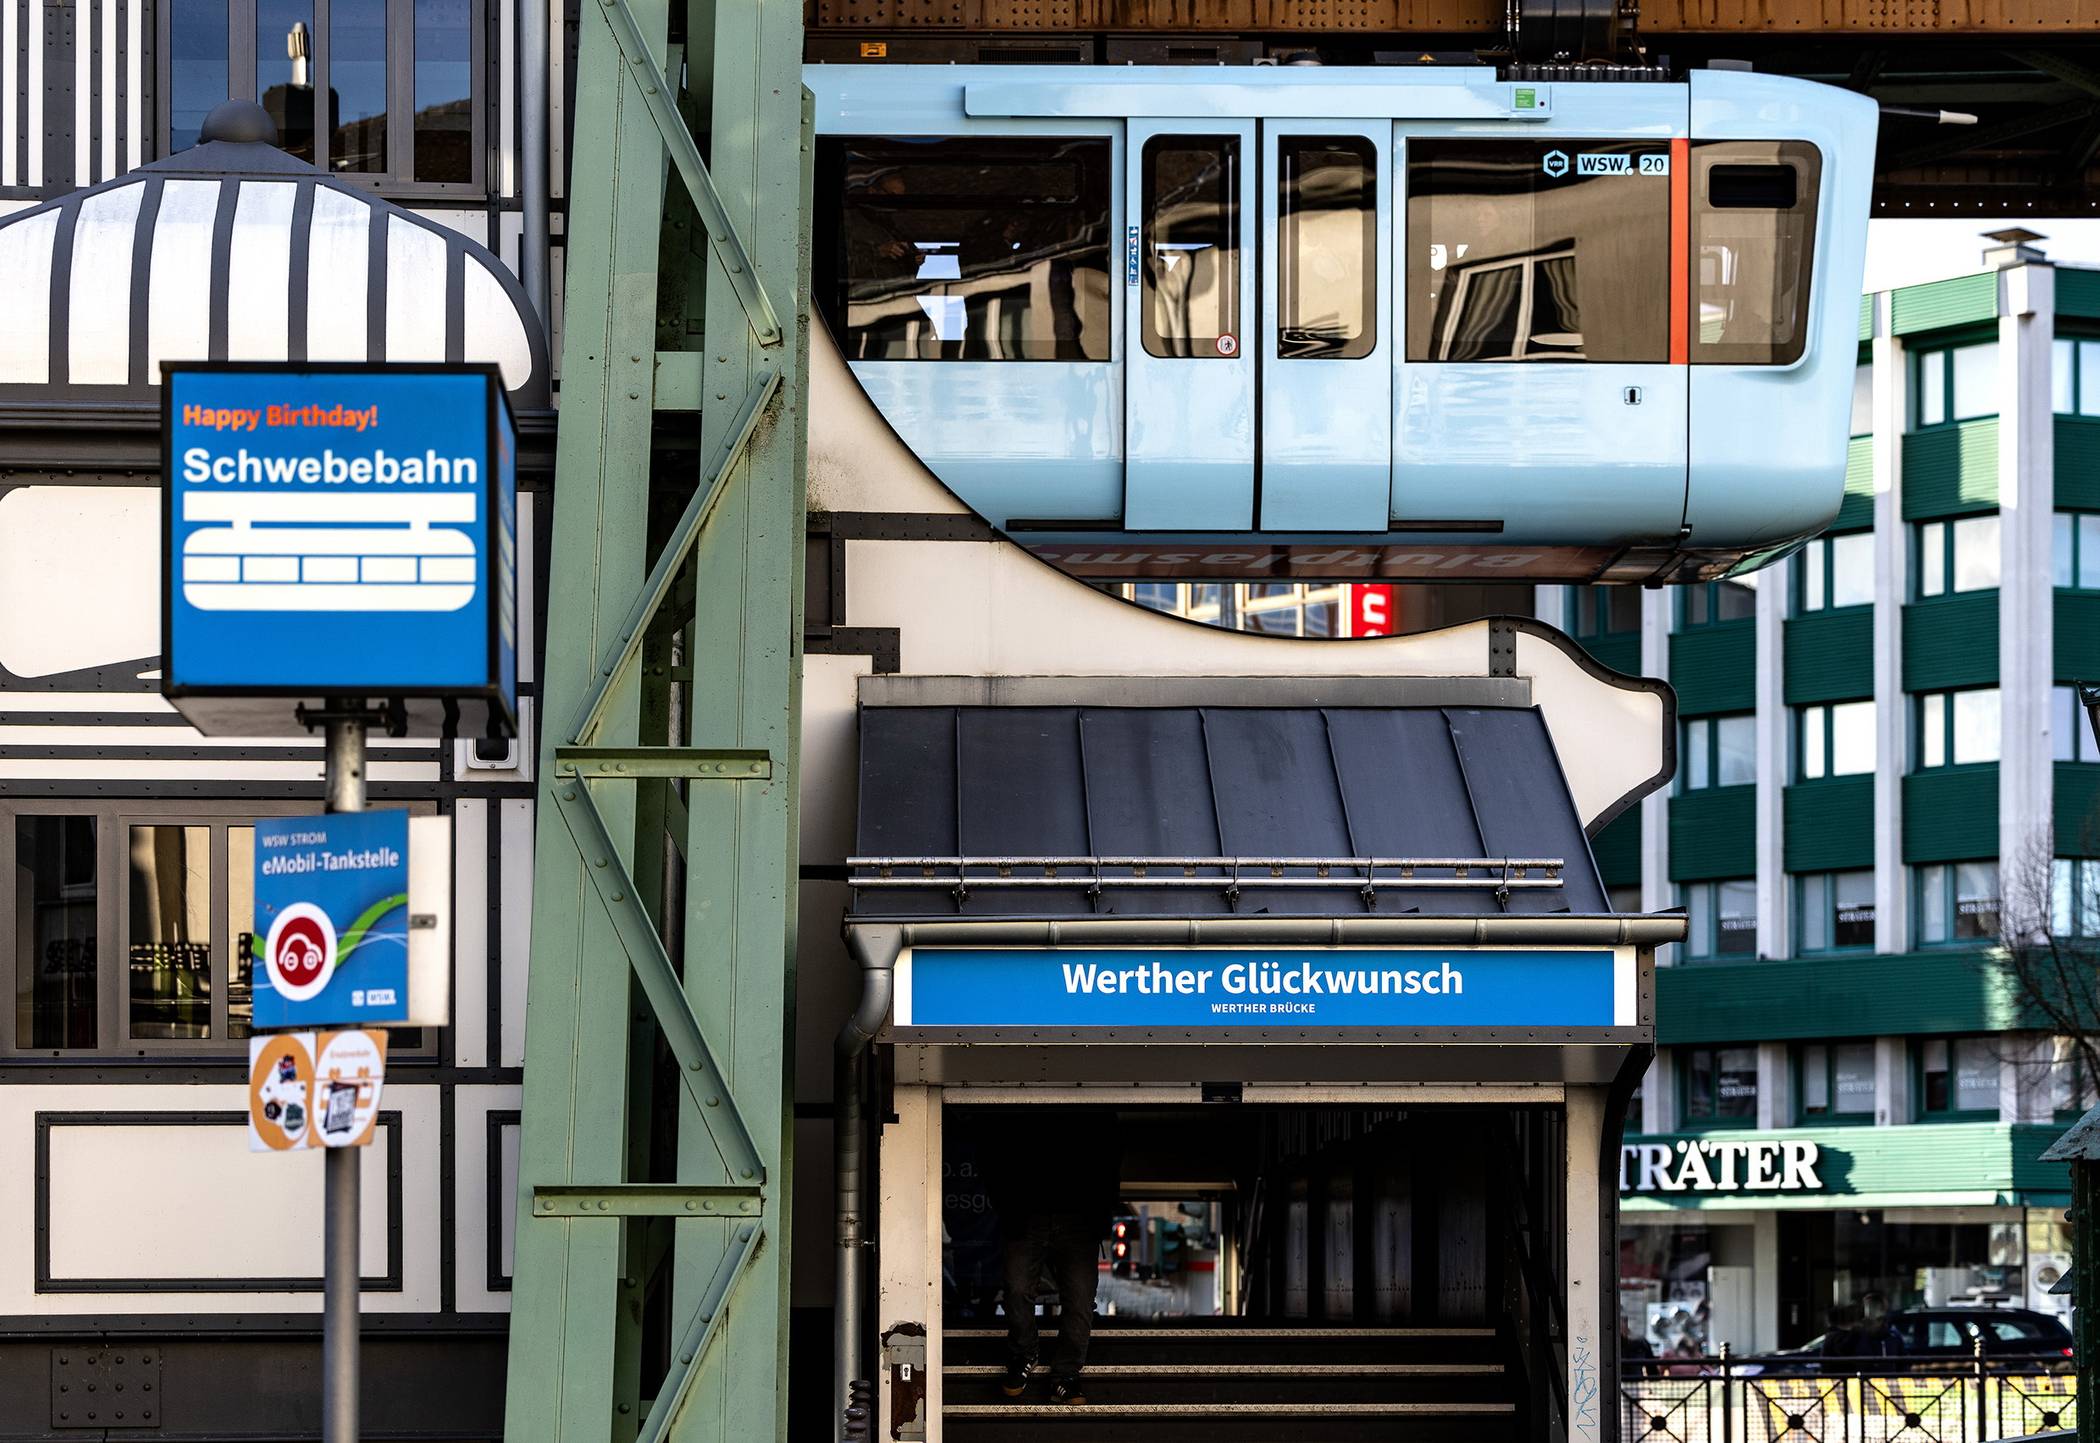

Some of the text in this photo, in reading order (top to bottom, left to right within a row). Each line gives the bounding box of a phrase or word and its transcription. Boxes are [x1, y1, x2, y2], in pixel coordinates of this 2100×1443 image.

[1642, 157, 1665, 172] 20
[183, 404, 378, 432] Happy Birthday!
[183, 447, 477, 484] Schwebebahn
[291, 832, 327, 846] STROM
[262, 847, 399, 875] eMobil-Tankstelle
[1062, 961, 1463, 995] Werther Glückwunsch
[1211, 1000, 1316, 1014] WERTHER BRÜCKE
